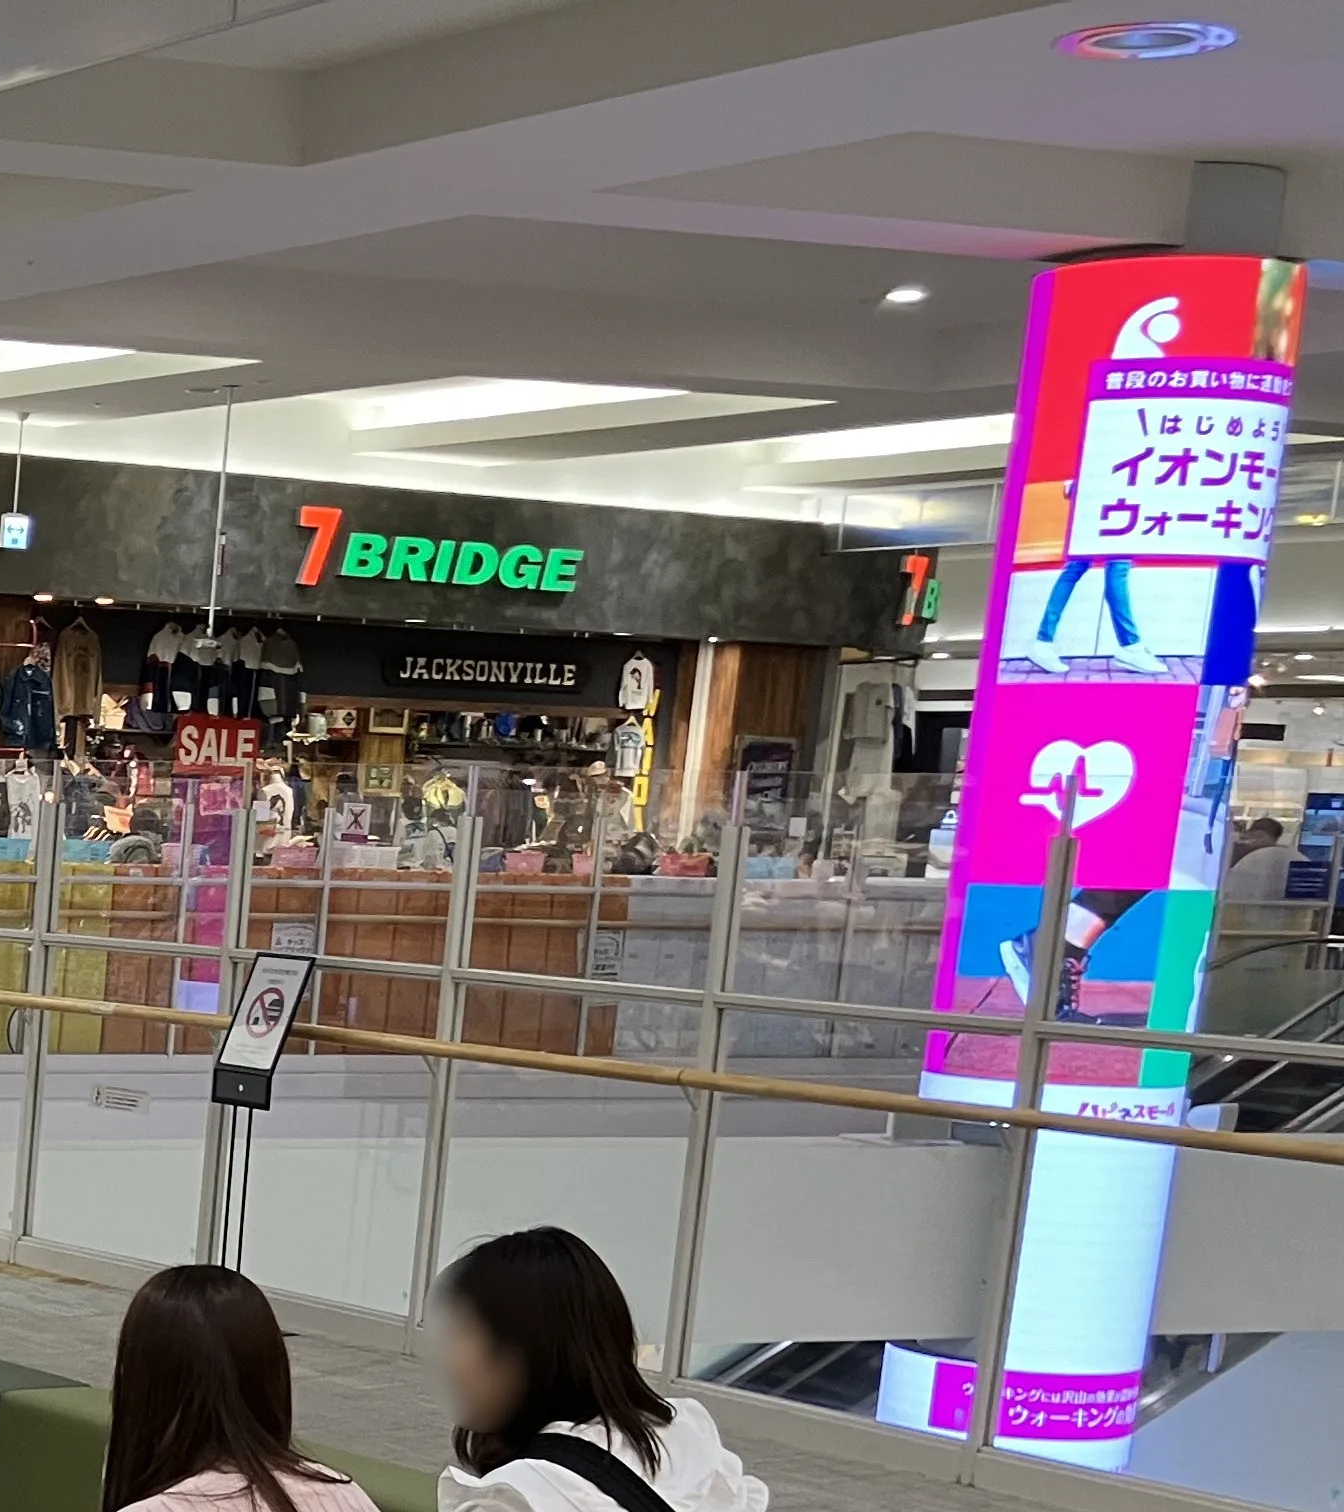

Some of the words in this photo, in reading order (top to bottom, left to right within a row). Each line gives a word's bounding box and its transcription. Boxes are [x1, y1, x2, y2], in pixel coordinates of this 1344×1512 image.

[295, 504, 343, 587] 7
[340, 531, 585, 593] BRIDGE
[399, 656, 577, 687] JACKSONVILLE
[178, 724, 258, 767] SALE
